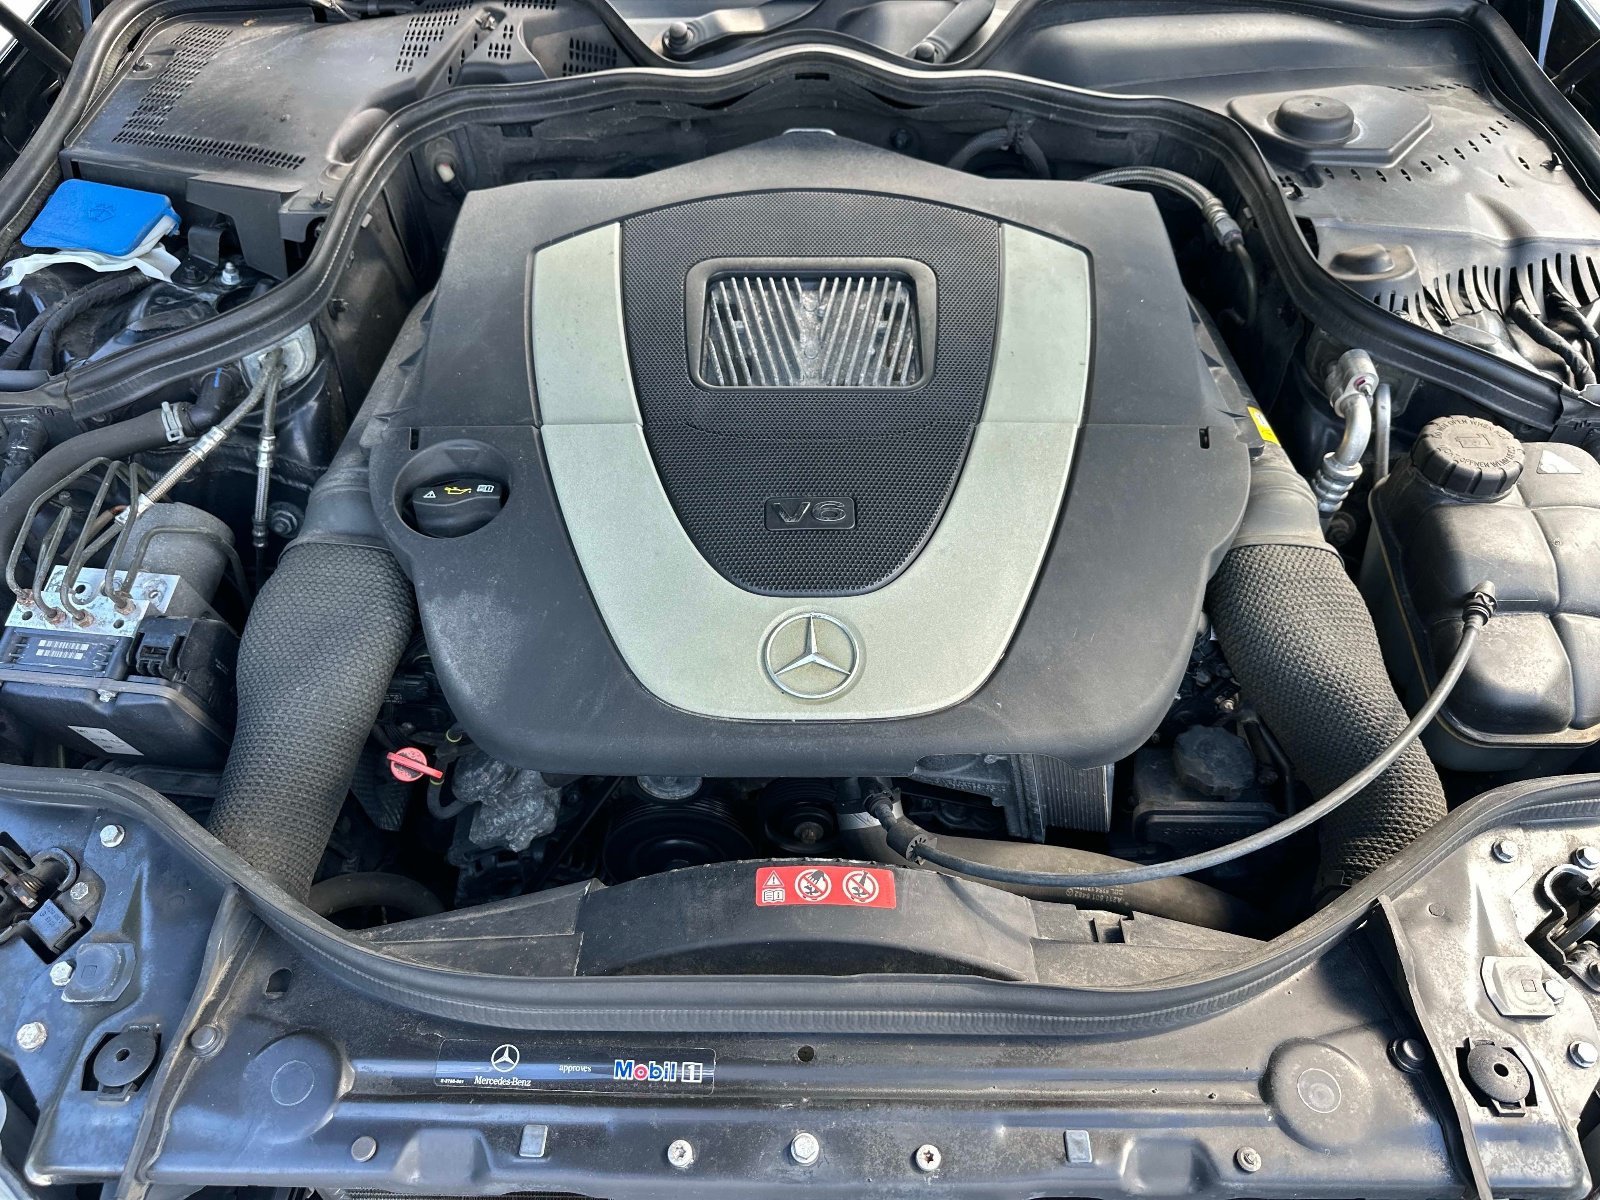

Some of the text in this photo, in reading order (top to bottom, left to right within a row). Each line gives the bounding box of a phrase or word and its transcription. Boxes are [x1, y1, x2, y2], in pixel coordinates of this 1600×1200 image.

[770, 500, 847, 523] V6
[558, 1064, 592, 1074] approves
[613, 1059, 678, 1082] Mobil
[474, 1075, 532, 1087] Mercedes-Benz
